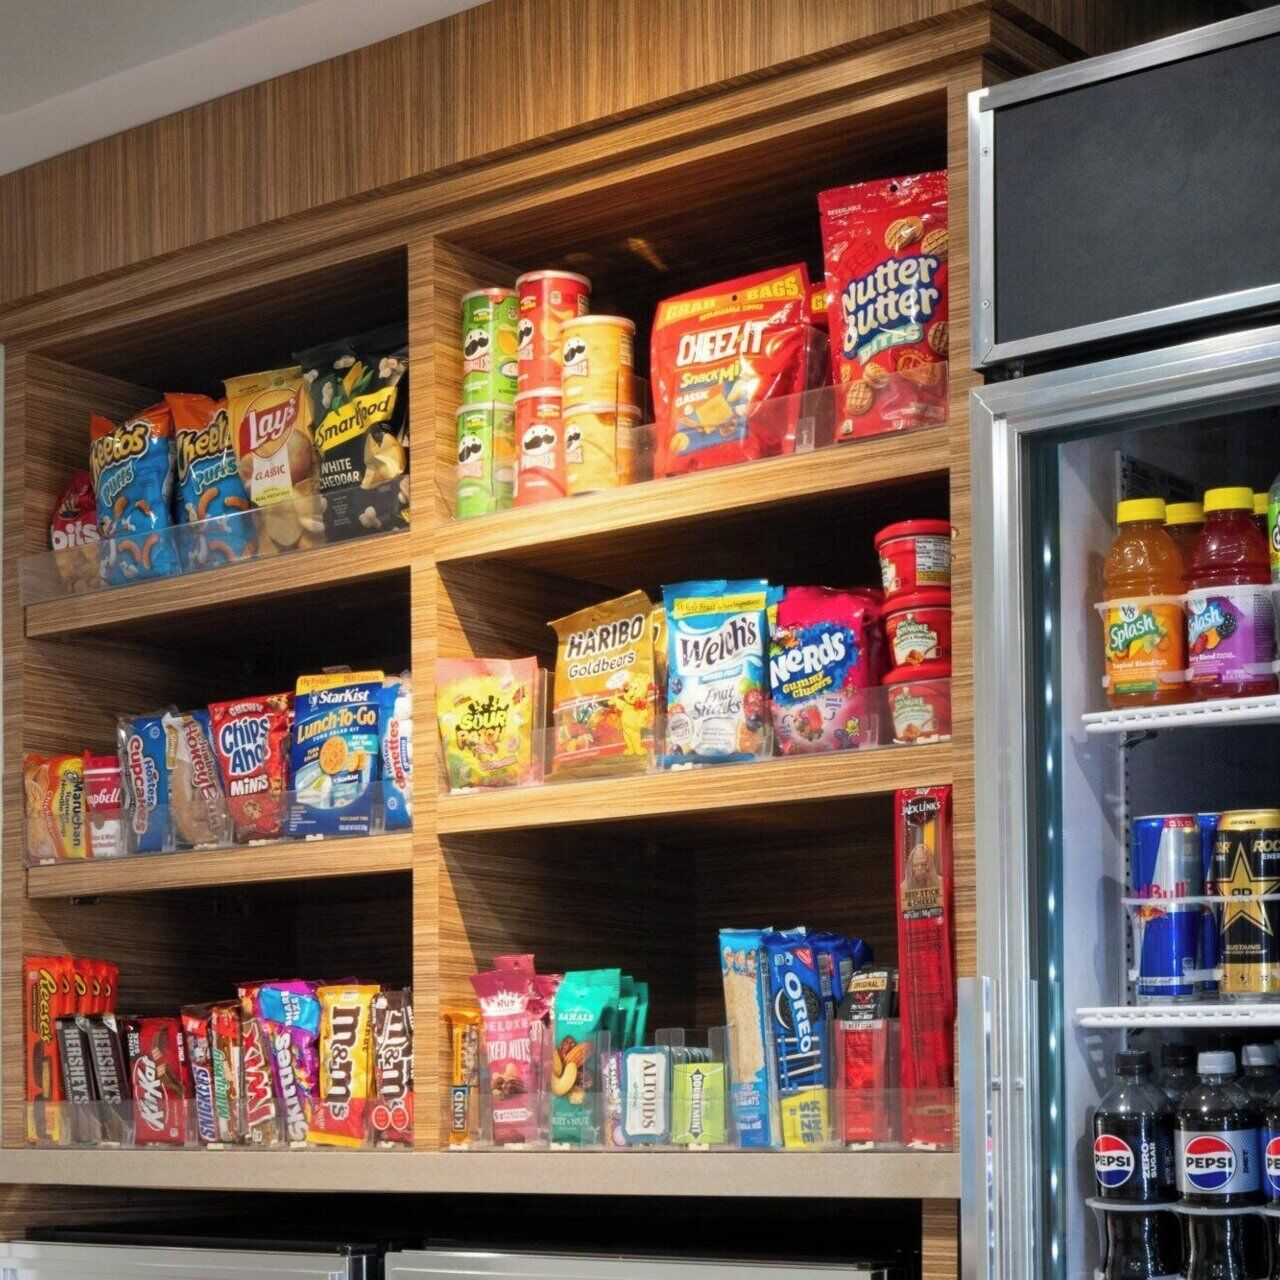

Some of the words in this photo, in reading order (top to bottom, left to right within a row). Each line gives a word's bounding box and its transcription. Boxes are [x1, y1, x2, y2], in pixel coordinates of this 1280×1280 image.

[746, 276, 799, 300] BAGS
[842, 256, 938, 318] Nutter
[842, 286, 940, 353] Butter
[859, 323, 922, 365] BITES
[249, 398, 297, 451] Lay's
[317, 394, 392, 448] Smartfood
[255, 464, 286, 481] CLASSIC
[320, 470, 360, 490] CHEDDAR
[322, 457, 353, 474] WHITE
[1121, 604, 1136, 618] V8
[566, 615, 645, 660] HARIBO
[680, 617, 757, 669] Welch's
[1110, 613, 1155, 649] Splash
[568, 650, 636, 679] Goldbears
[1135, 659, 1155, 667] Blend
[320, 688, 371, 704] StarKist
[220, 716, 270, 756] Chips
[461, 713, 508, 730] SOUR
[71, 776, 83, 848] Maruchan
[853, 980, 880, 989] ORIGINAL
[558, 1012, 594, 1022] SAHALE
[784, 971, 813, 1053] OREO
[64, 1028, 89, 1105] HERSHEY'S
[93, 1028, 121, 1105] HERSHEY'S
[508, 1038, 532, 1062] NUTS
[243, 1021, 275, 1126] TWIX
[193, 1064, 217, 1142] SNICKERS
[453, 1090, 465, 1129] KIND
[640, 1060, 658, 1129] ALTOIDS
[692, 1073, 704, 1134] DOUBLEMINT
[1094, 1155, 1131, 1169] PEPSI
[1141, 1142, 1149, 1179] ZERO
[1149, 1142, 1157, 1179] SUGAR
[1186, 1156, 1233, 1169] PEPSI
